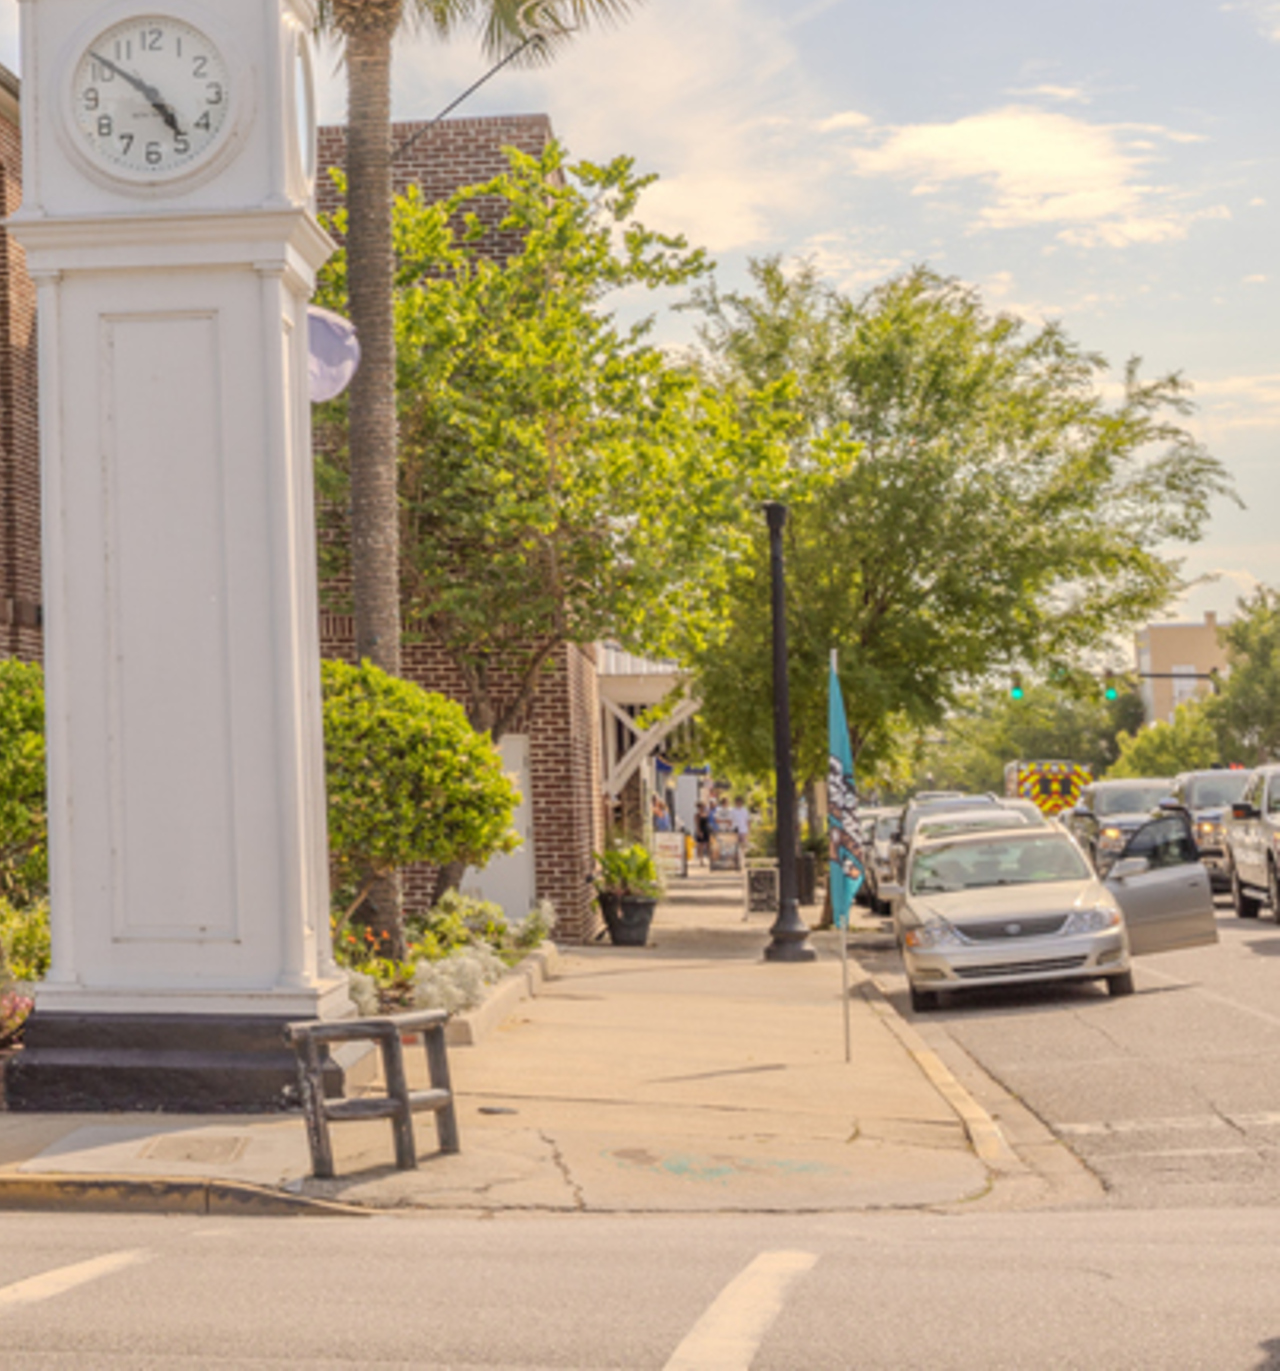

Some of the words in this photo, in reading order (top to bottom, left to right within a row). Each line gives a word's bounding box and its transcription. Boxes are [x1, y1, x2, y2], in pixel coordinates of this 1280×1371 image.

[115, 40, 132, 61] 11
[141, 29, 163, 51] 12
[91, 62, 115, 83] 10
[192, 55, 208, 78] 2
[83, 88, 99, 111] 9
[206, 81, 223, 105] 3
[97, 114, 112, 137] 8
[193, 111, 211, 133] 4
[119, 133, 134, 155] 7
[145, 141, 162, 165] 6
[173, 131, 190, 154] 5
